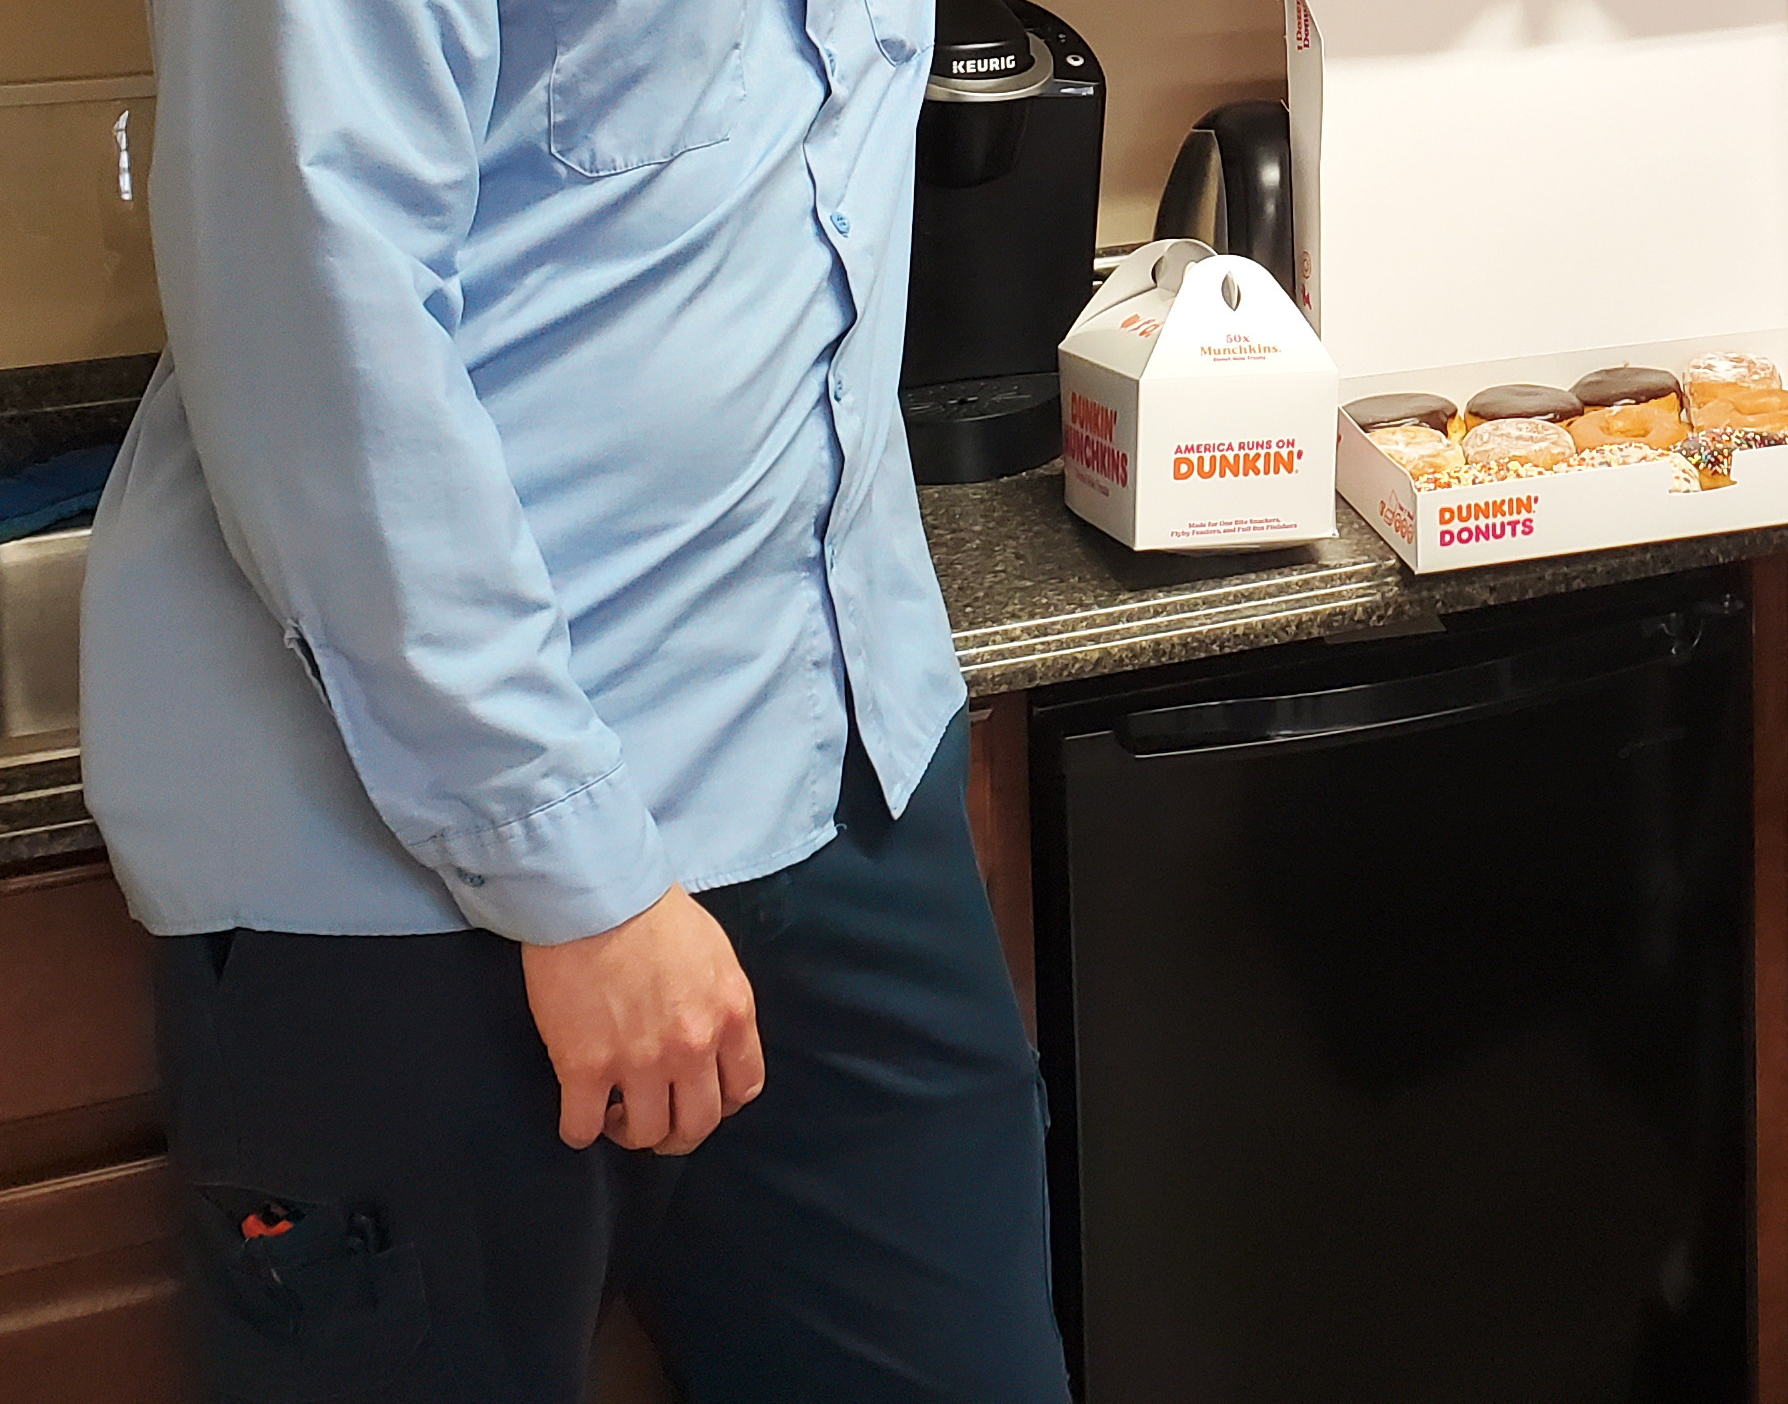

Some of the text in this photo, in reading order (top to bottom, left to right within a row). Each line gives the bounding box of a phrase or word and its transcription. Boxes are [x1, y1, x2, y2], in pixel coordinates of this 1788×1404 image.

[952, 55, 1016, 74] KEURIG
[1225, 333, 1251, 343] 50x
[1174, 438, 1295, 455] AMERICA RUNS ON
[1172, 449, 1304, 481] DUNKIN'
[1438, 494, 1540, 526] DUNKIN'
[1439, 517, 1535, 547] DONUTS
